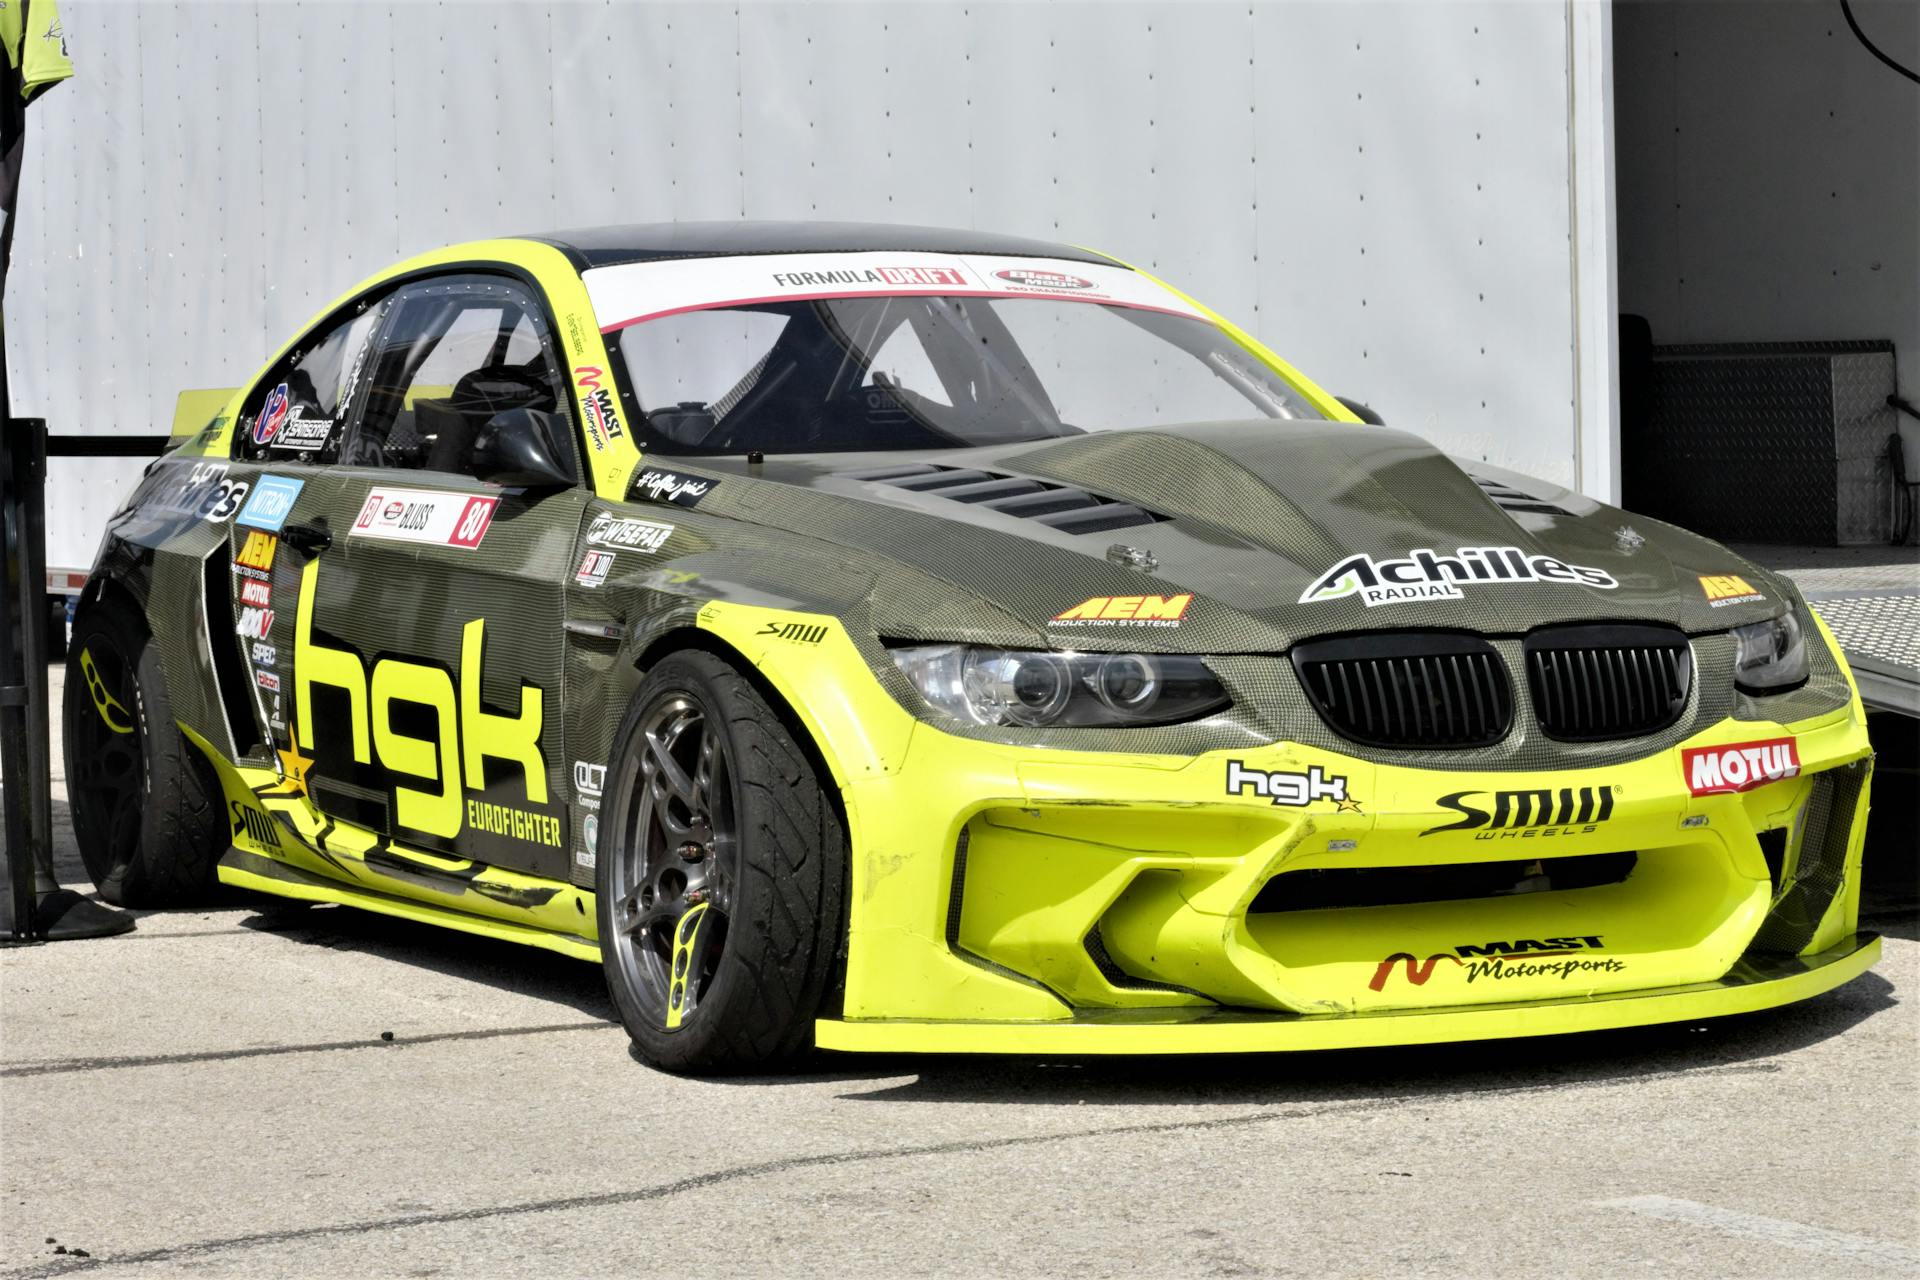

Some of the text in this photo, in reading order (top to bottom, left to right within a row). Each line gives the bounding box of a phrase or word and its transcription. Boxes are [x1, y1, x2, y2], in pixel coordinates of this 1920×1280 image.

[773, 268, 961, 287] FORMULA DRIFT
[1009, 271, 1081, 284] Black
[1024, 278, 1081, 289] Magic
[581, 395, 604, 452] Motorsports
[595, 389, 623, 439] MAST
[399, 503, 435, 531] BLUSS
[457, 501, 492, 541] 80
[603, 521, 673, 549] WISEFAB
[236, 531, 277, 571] AEM
[1303, 550, 1617, 600] Achilles
[1699, 575, 1759, 600] AEM
[242, 582, 270, 605] MOTUL
[1367, 584, 1451, 603] RADIAL
[1055, 594, 1192, 620] AEM
[1047, 619, 1180, 628] INDUCTION SYSTEMS
[251, 642, 277, 666] SPEC
[295, 557, 549, 839] hgk
[1691, 743, 1798, 790] MOTUL
[1227, 760, 1347, 808] hgk
[467, 799, 562, 848] EUROFIGHTER
[1474, 824, 1598, 841] WHEELS
[1454, 935, 1605, 959] MAST
[1463, 957, 1628, 984] Motorsports
